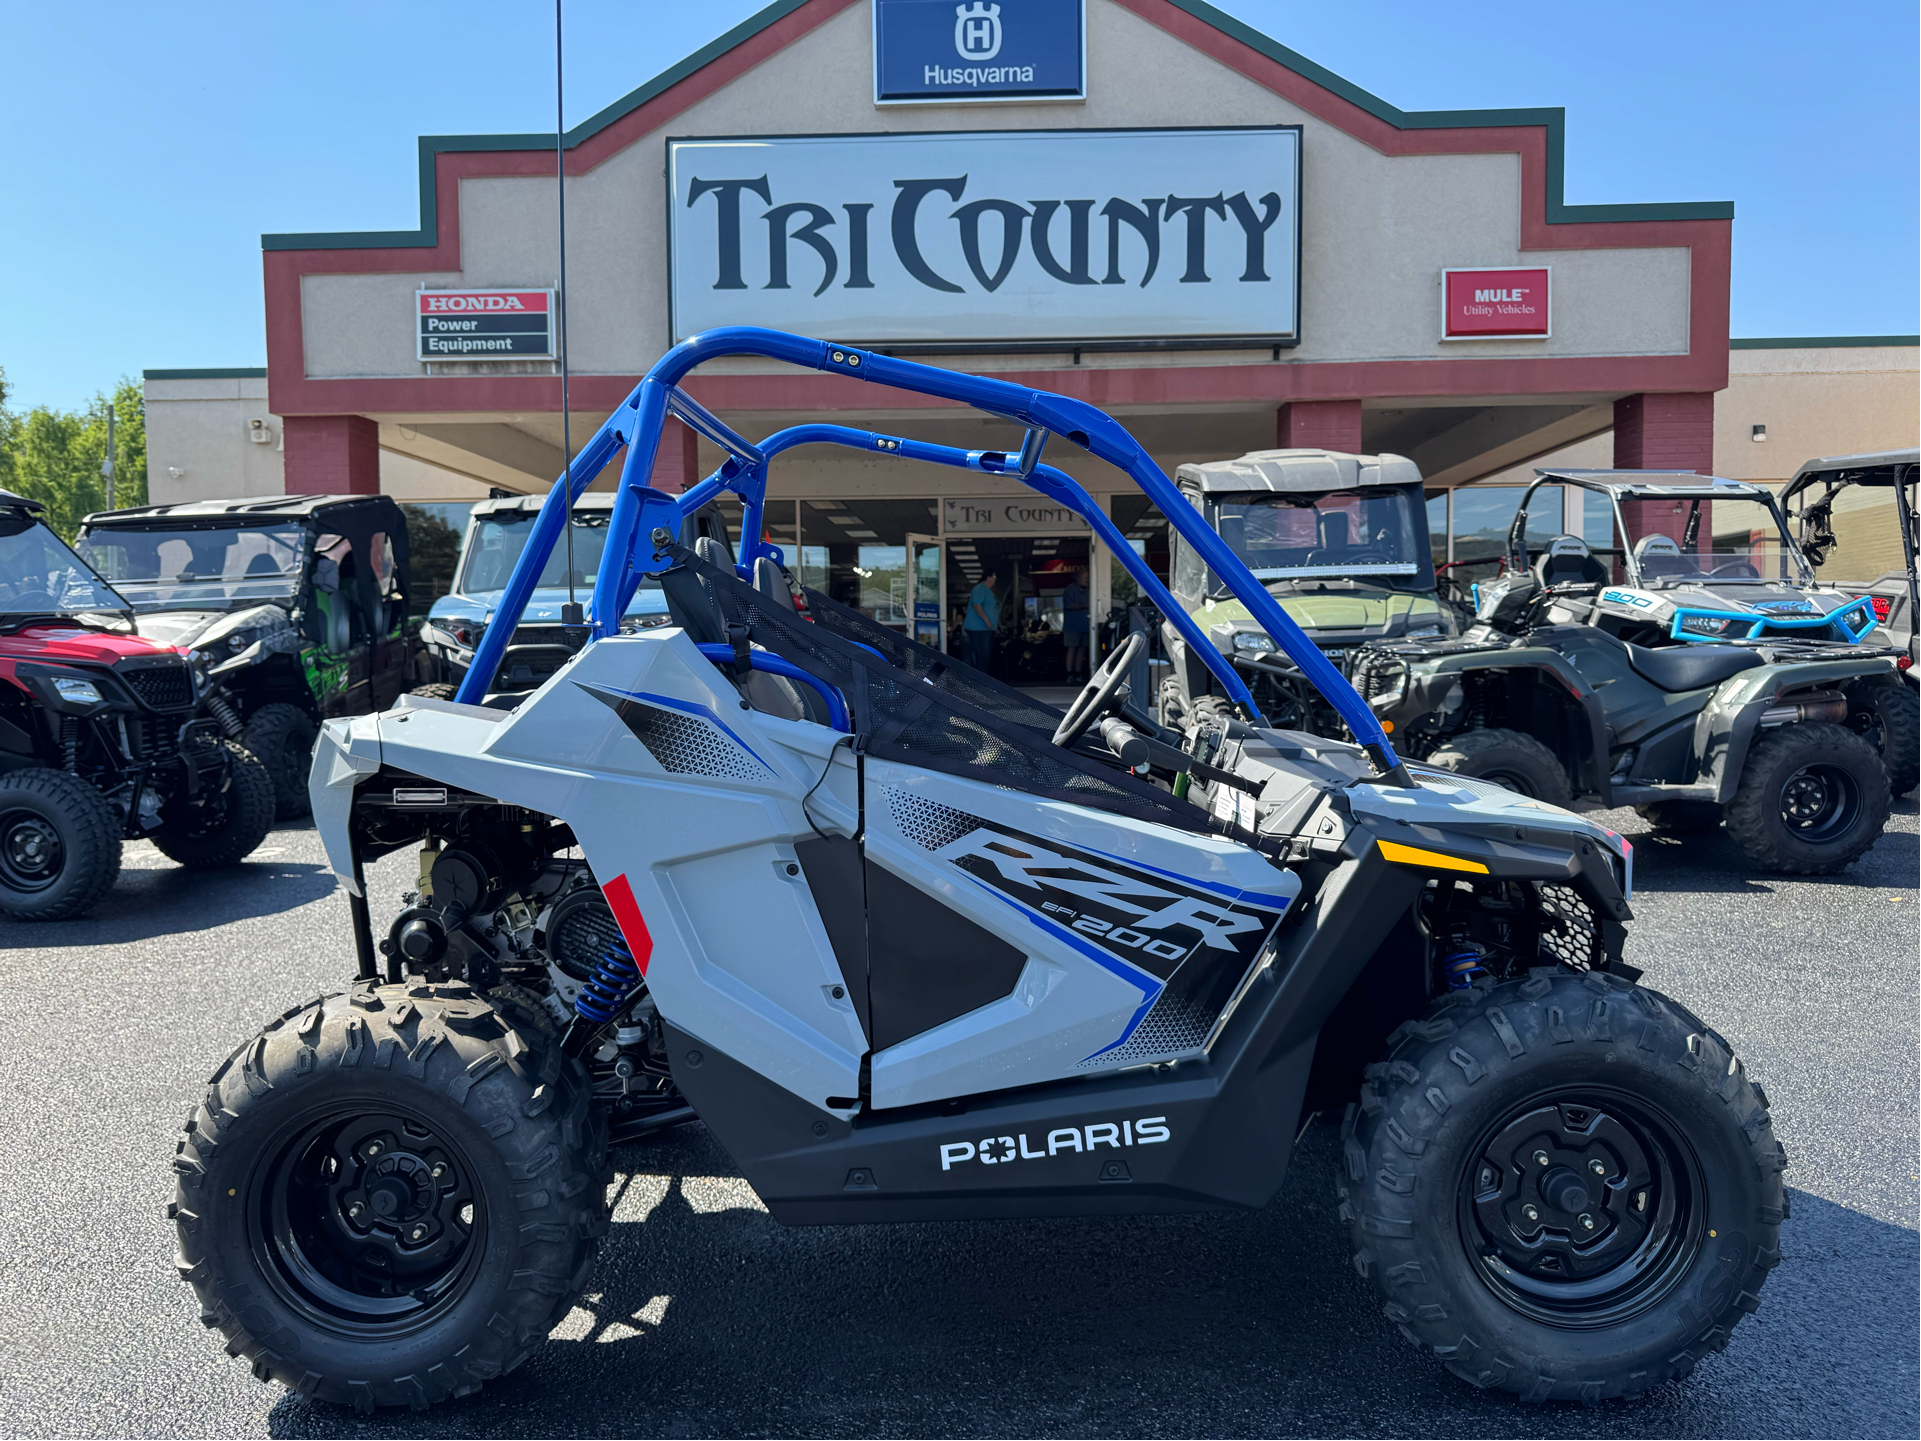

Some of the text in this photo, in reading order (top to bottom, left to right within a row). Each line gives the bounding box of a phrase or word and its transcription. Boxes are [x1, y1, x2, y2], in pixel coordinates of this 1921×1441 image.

[427, 296, 525, 311] HONDA
[1463, 304, 1536, 317] Utility Vehicles
[428, 318, 478, 331] Power
[428, 337, 513, 353] Equipment
[938, 827, 1264, 953] RZR
[1040, 901, 1188, 961] EFI 200
[939, 1116, 1172, 1172] POLARIS
